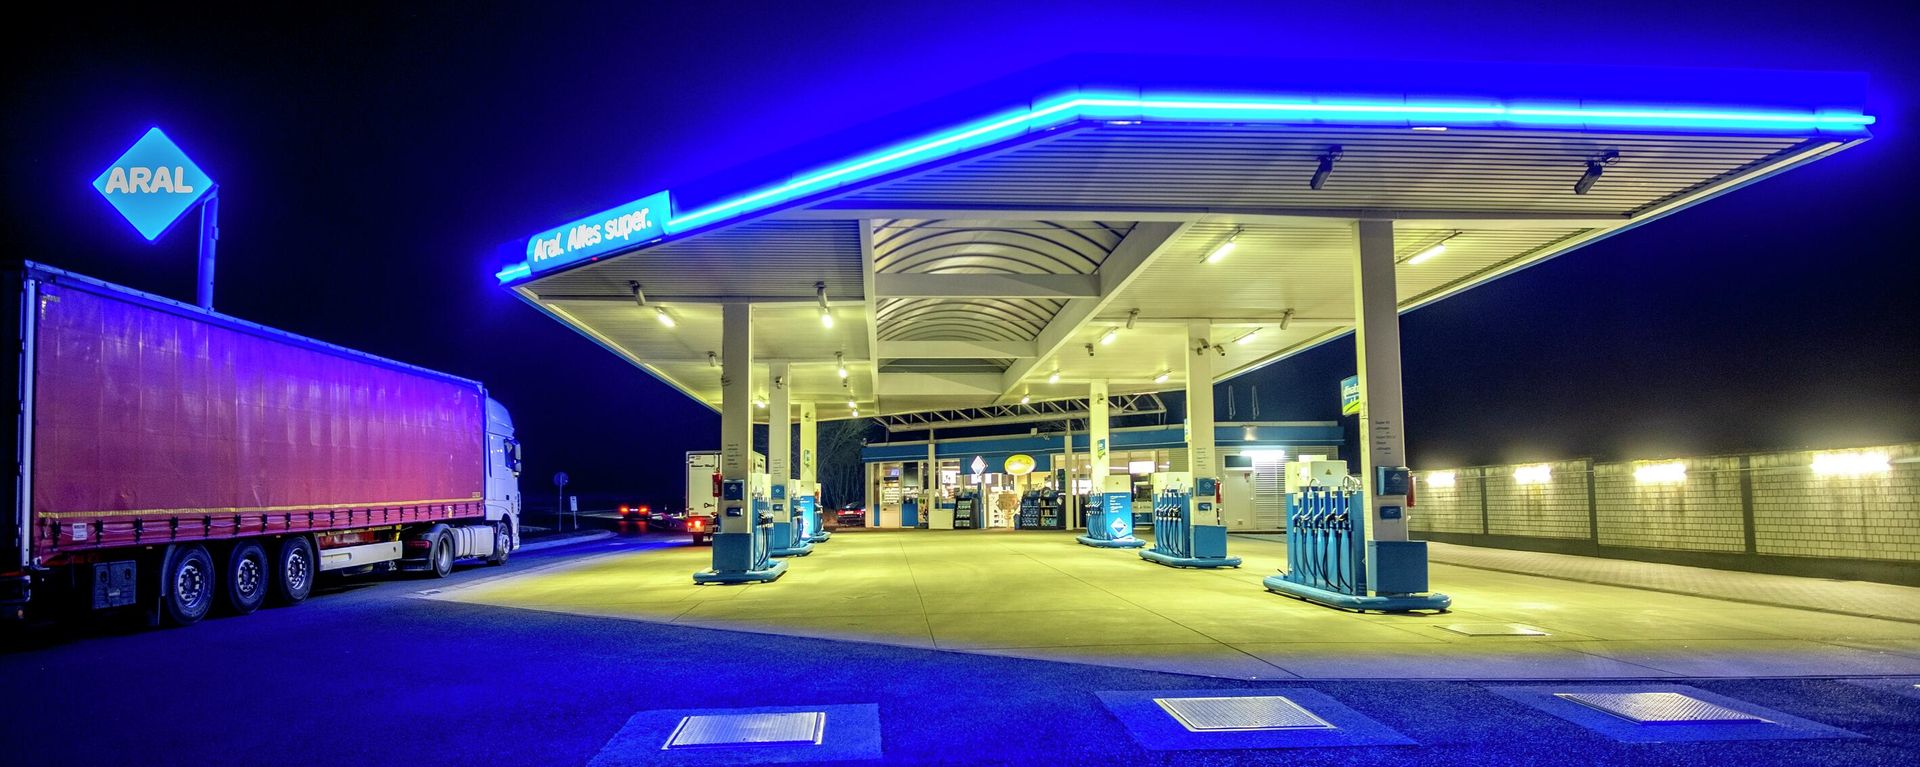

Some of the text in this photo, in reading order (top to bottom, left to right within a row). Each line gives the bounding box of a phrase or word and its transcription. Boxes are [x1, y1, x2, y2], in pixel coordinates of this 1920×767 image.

[105, 167, 193, 193] ARAL
[534, 208, 651, 261] Aral. Alles super.
